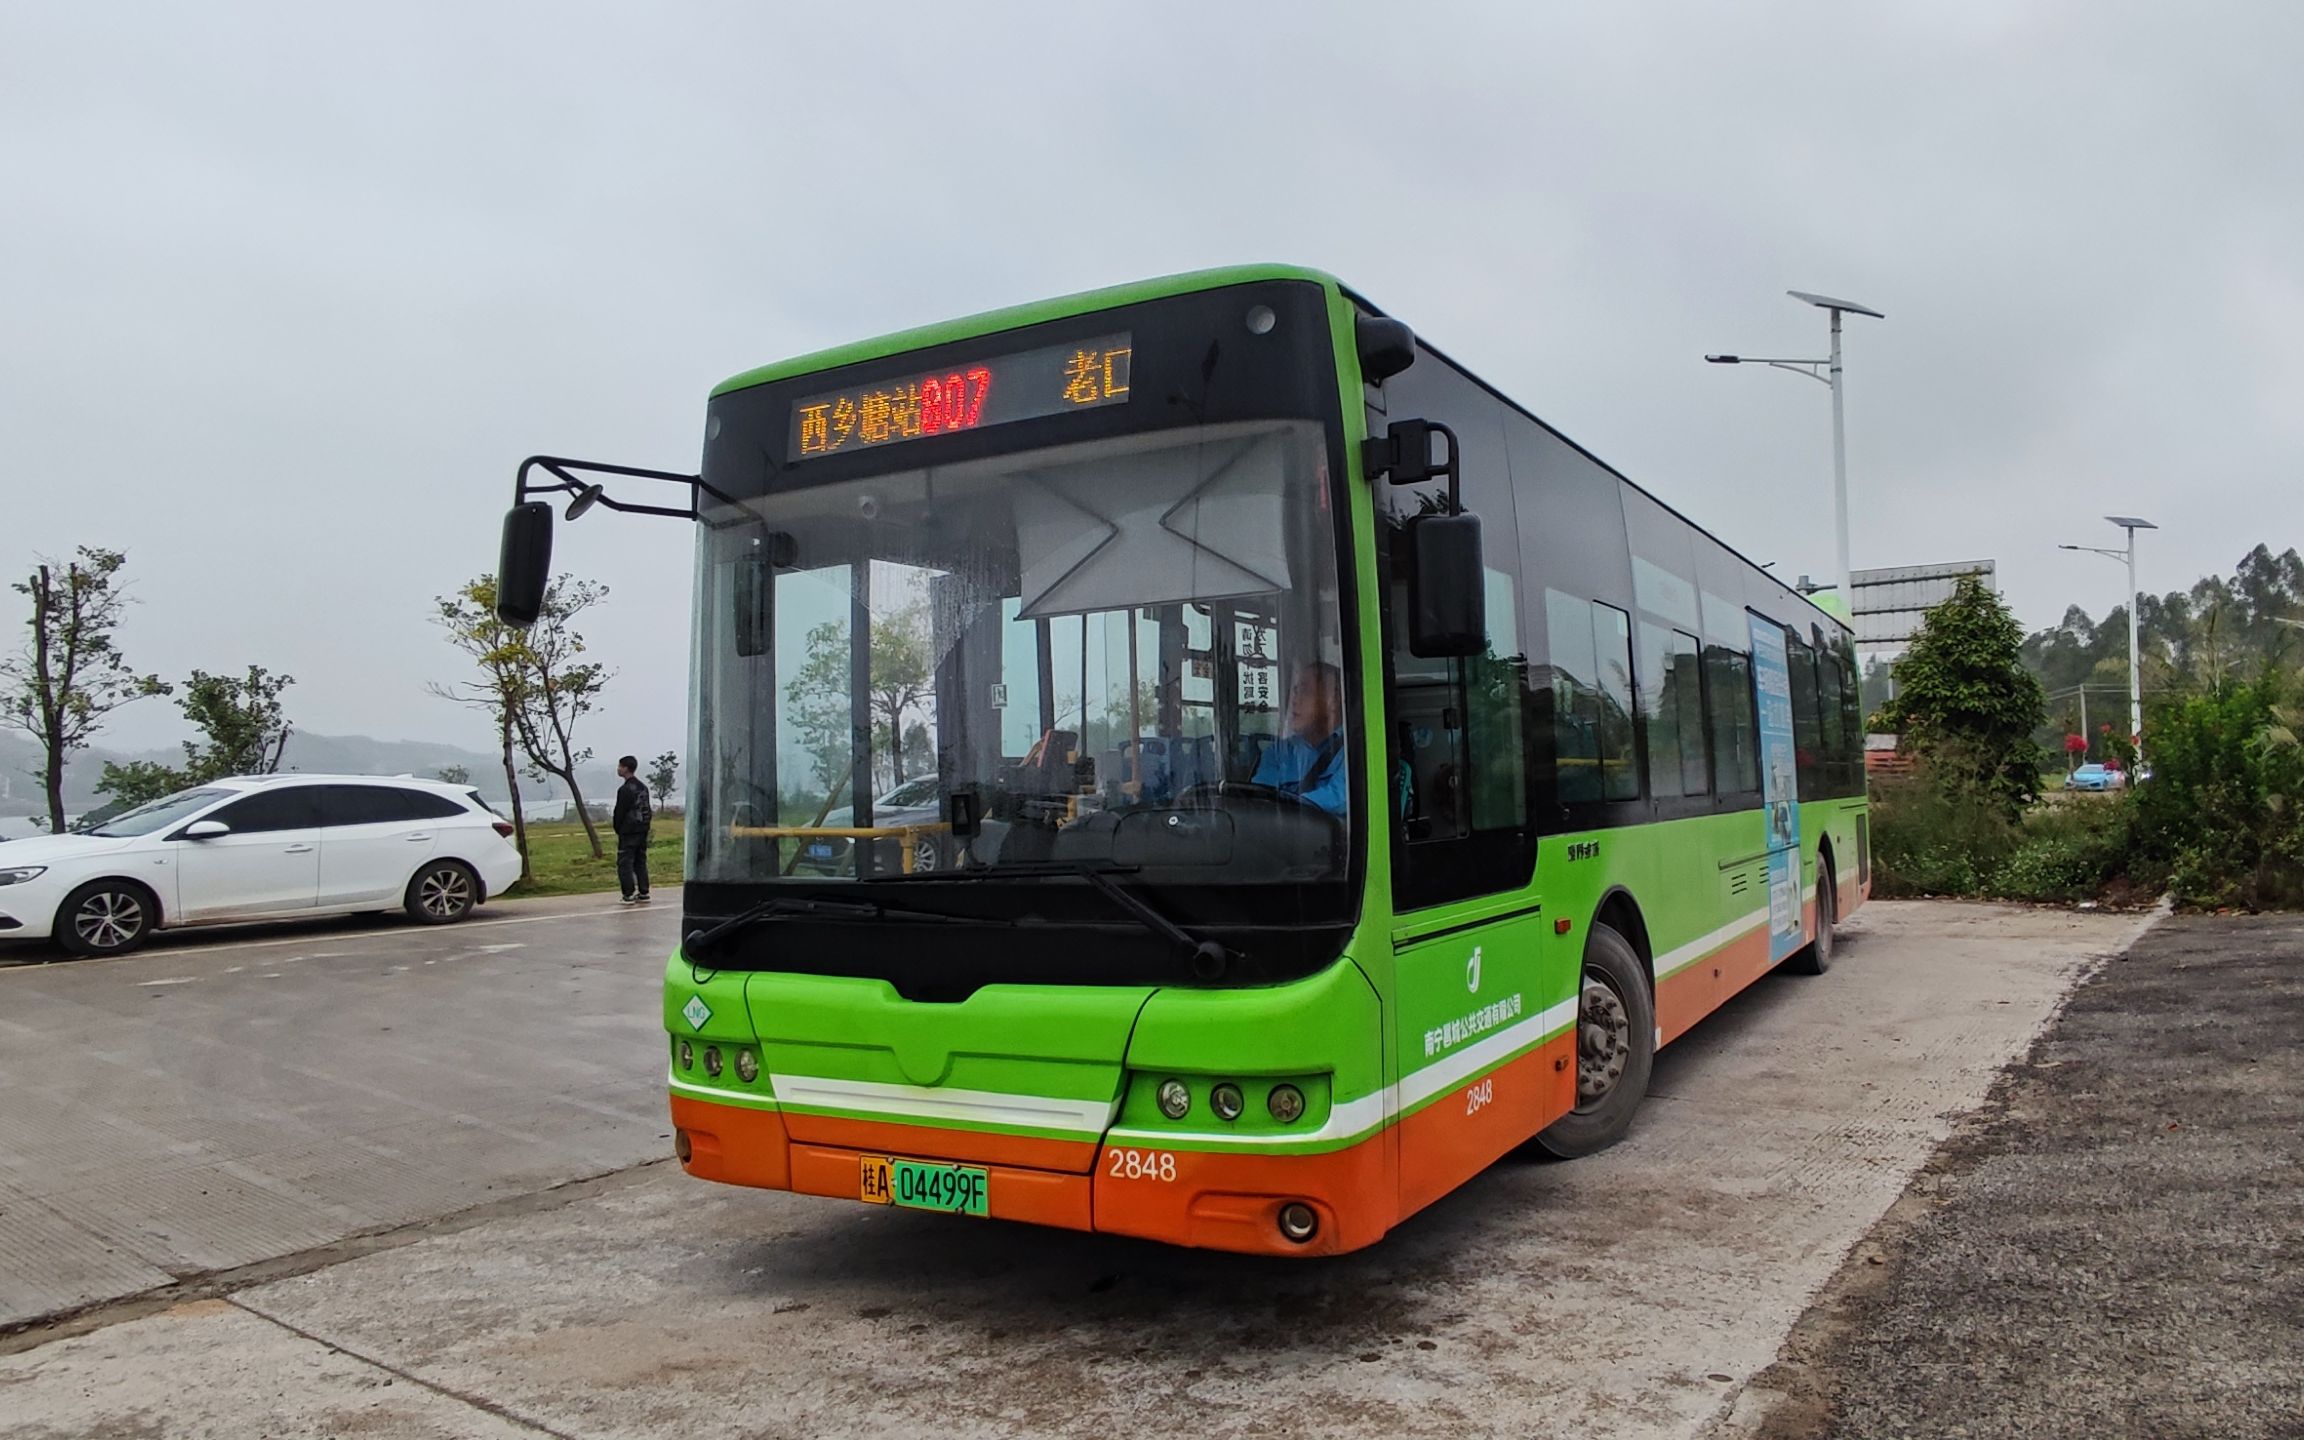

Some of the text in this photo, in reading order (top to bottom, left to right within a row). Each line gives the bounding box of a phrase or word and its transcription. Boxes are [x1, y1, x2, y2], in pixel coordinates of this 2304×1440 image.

[799, 383, 922, 455] 西乡塘站
[687, 1005, 706, 1020] LNG
[1466, 1078, 1493, 1115] 2848
[1108, 1148, 1177, 1182] 2848
